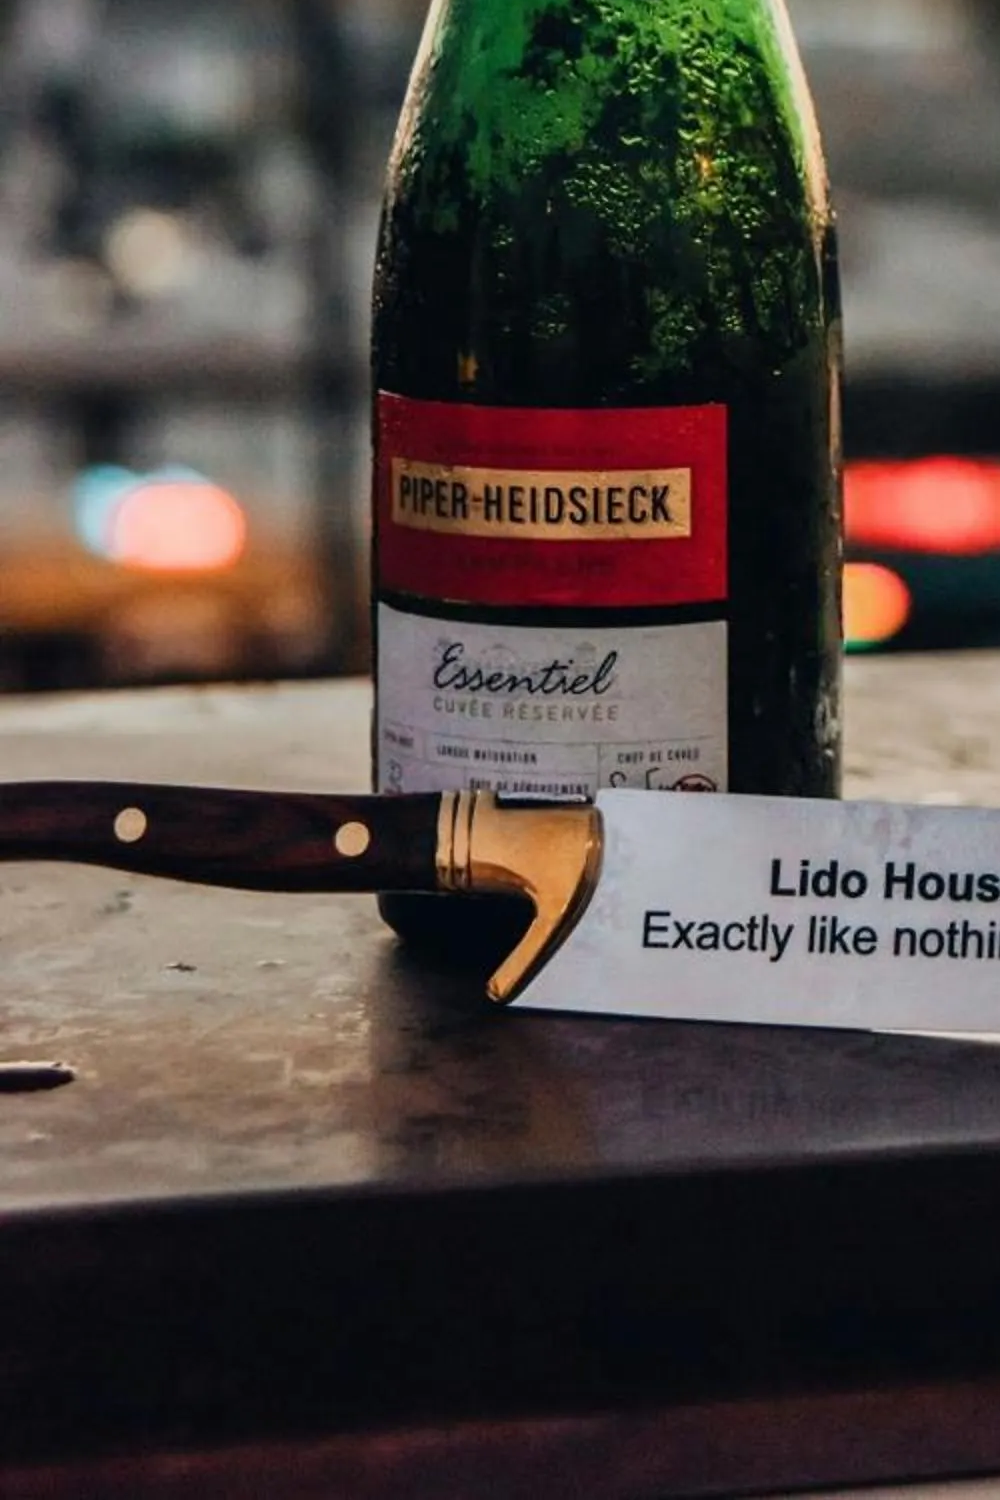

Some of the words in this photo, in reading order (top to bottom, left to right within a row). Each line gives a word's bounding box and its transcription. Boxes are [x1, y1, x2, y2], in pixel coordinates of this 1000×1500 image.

[400, 474, 673, 525] PIPER-HEIDSIECK
[433, 642, 618, 695] Essentiel
[433, 696, 493, 719] CUVÉE
[502, 702, 619, 722] RÉSERVÉE
[769, 859, 868, 899] Lido
[642, 910, 794, 963] Exactly
[807, 916, 878, 956] like
